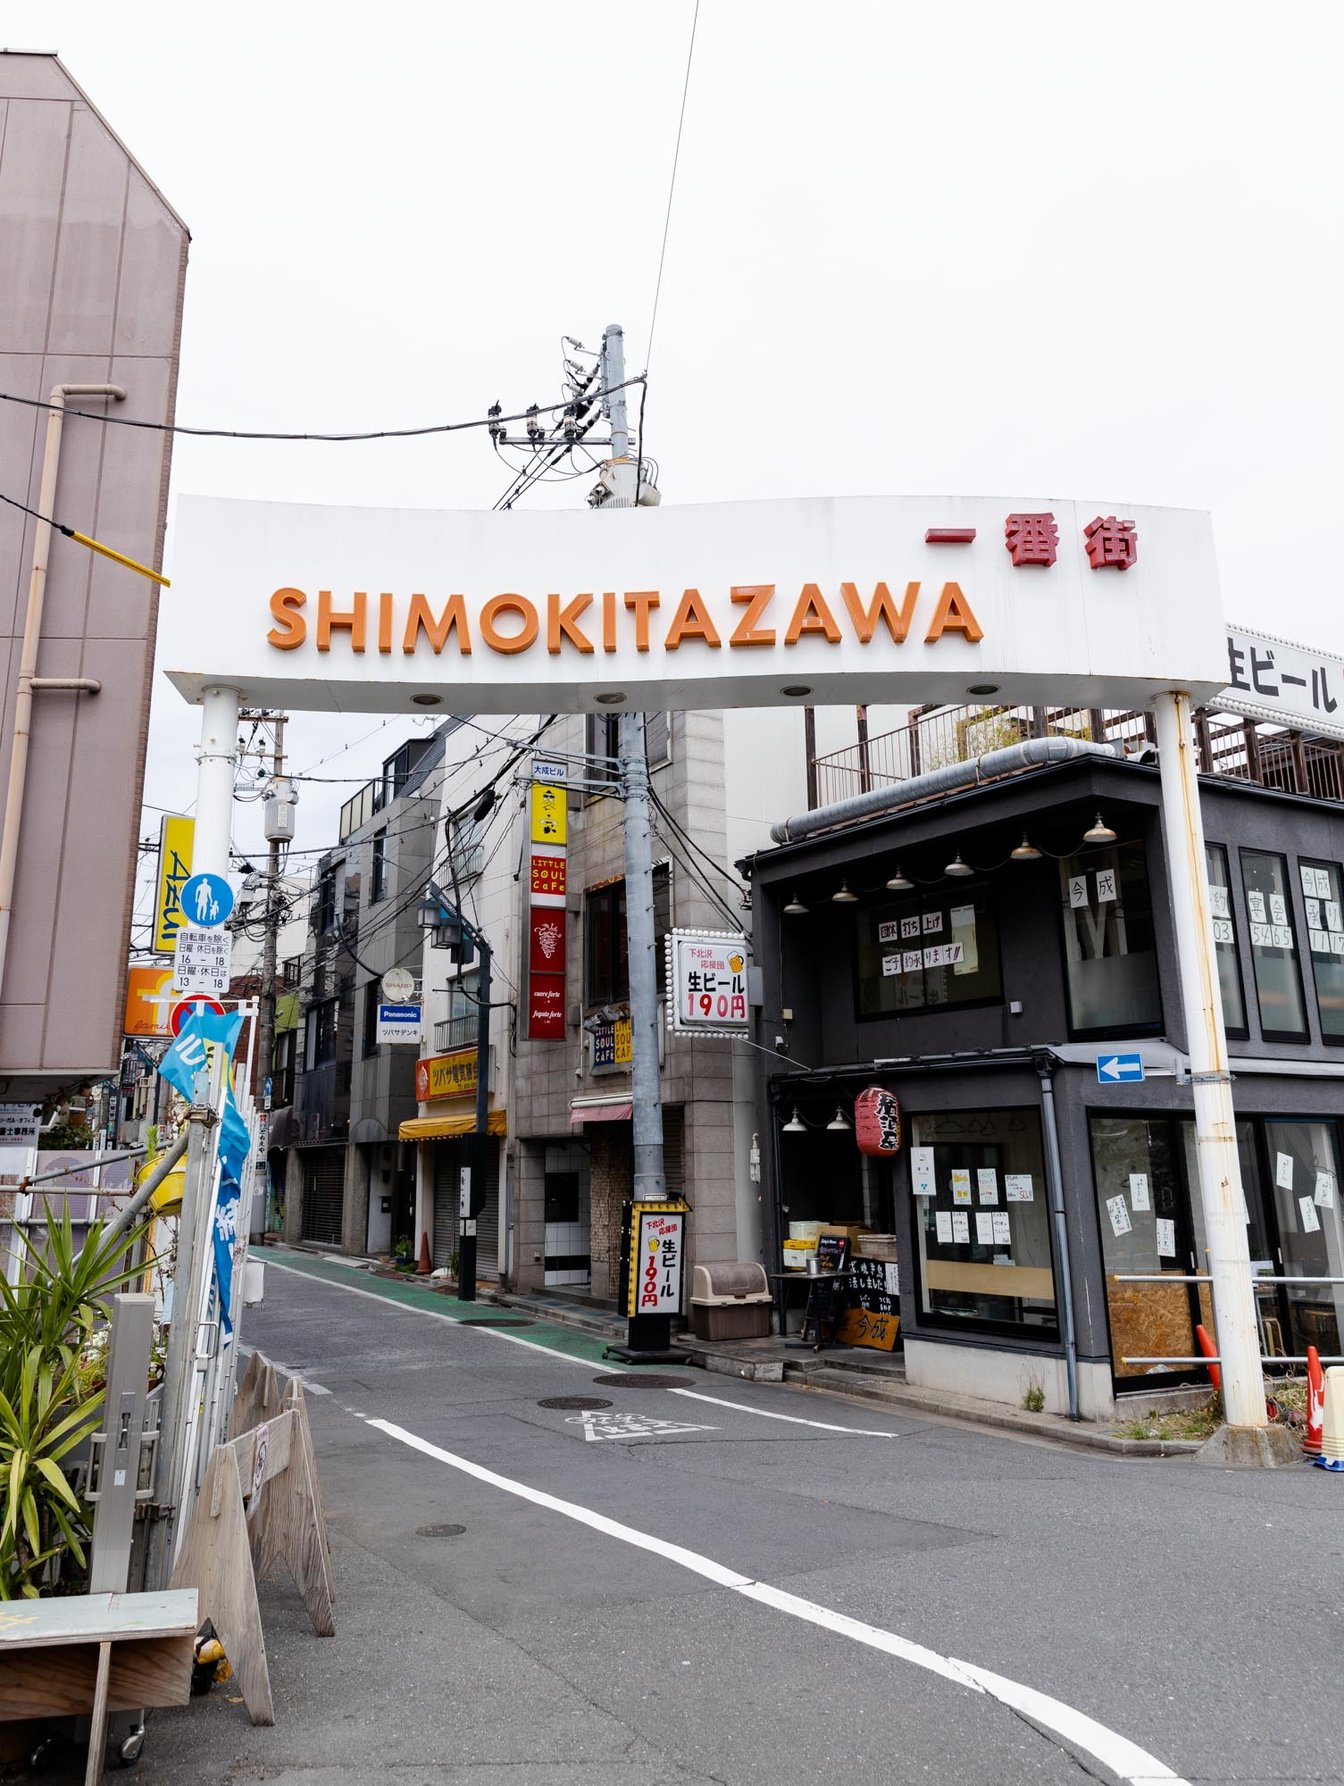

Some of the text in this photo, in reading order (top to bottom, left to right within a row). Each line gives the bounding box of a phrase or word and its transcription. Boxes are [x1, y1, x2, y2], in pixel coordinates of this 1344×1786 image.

[925, 512, 1138, 570] 一番街
[267, 581, 984, 656] SHIMOKITAZAWA
[533, 764, 565, 777] 大成ビル
[532, 858, 566, 869] LITTLE
[531, 868, 565, 881] SOUL
[1071, 875, 1114, 902] 今成
[180, 932, 229, 944] 自転車を除く
[1212, 920, 1231, 942] 03
[1252, 926, 1292, 946] 5465
[181, 954, 191, 964] 16
[215, 956, 225, 966] 18
[689, 948, 713, 959] 下北沢
[180, 977, 190, 987] 13
[213, 978, 223, 988] 18
[688, 971, 745, 994] 生ビール
[688, 993, 746, 1019] 190円
[383, 1010, 418, 1018] Panasonic
[595, 1036, 614, 1049] SOUL
[646, 1218, 665, 1230] 下北沢
[660, 1239, 678, 1298] 生ビール
[641, 1255, 658, 1307] 190円
[857, 1313, 890, 1341] 今成
